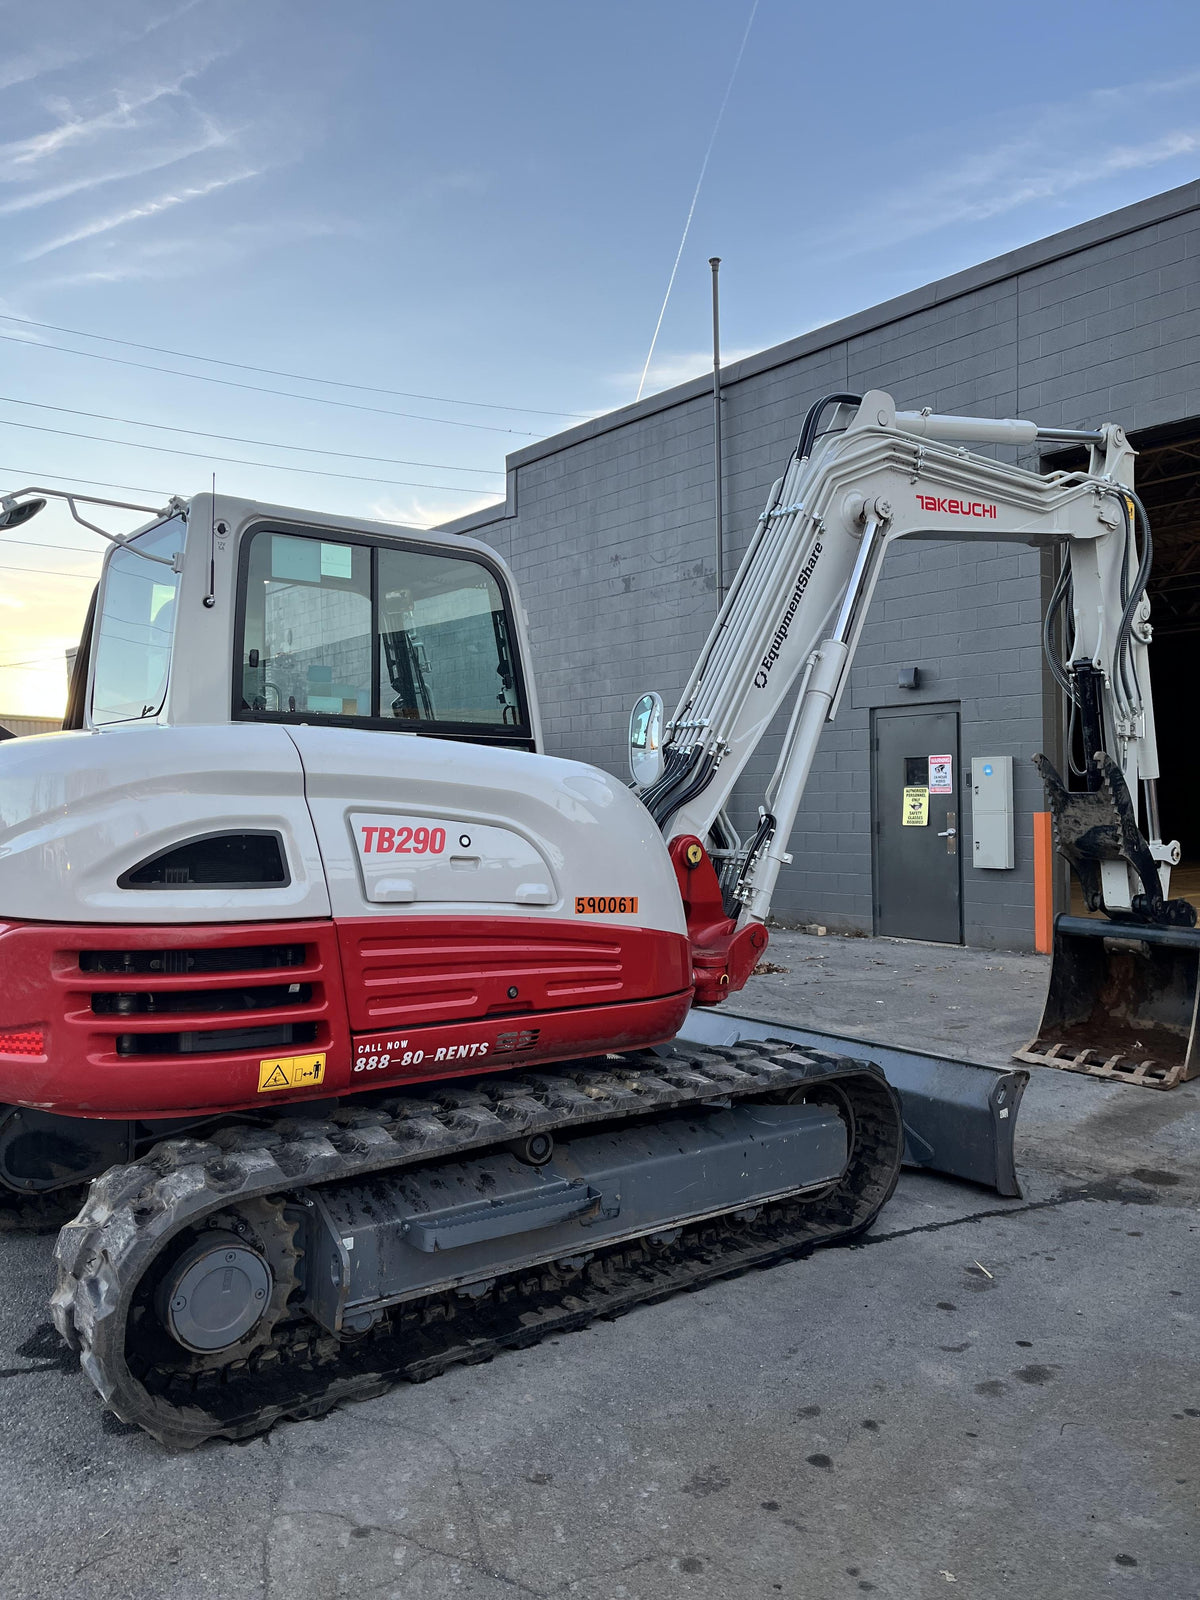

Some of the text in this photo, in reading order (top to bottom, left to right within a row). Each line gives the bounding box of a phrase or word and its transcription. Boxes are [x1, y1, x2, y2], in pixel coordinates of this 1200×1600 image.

[916, 495, 997, 519] TAKEUCHI
[764, 541, 823, 672] EquipmentShare
[361, 826, 446, 854] TB290
[576, 897, 636, 914] 590061
[354, 1042, 489, 1072] 888-80-RENTS
[358, 1040, 409, 1054] CALL NOW
